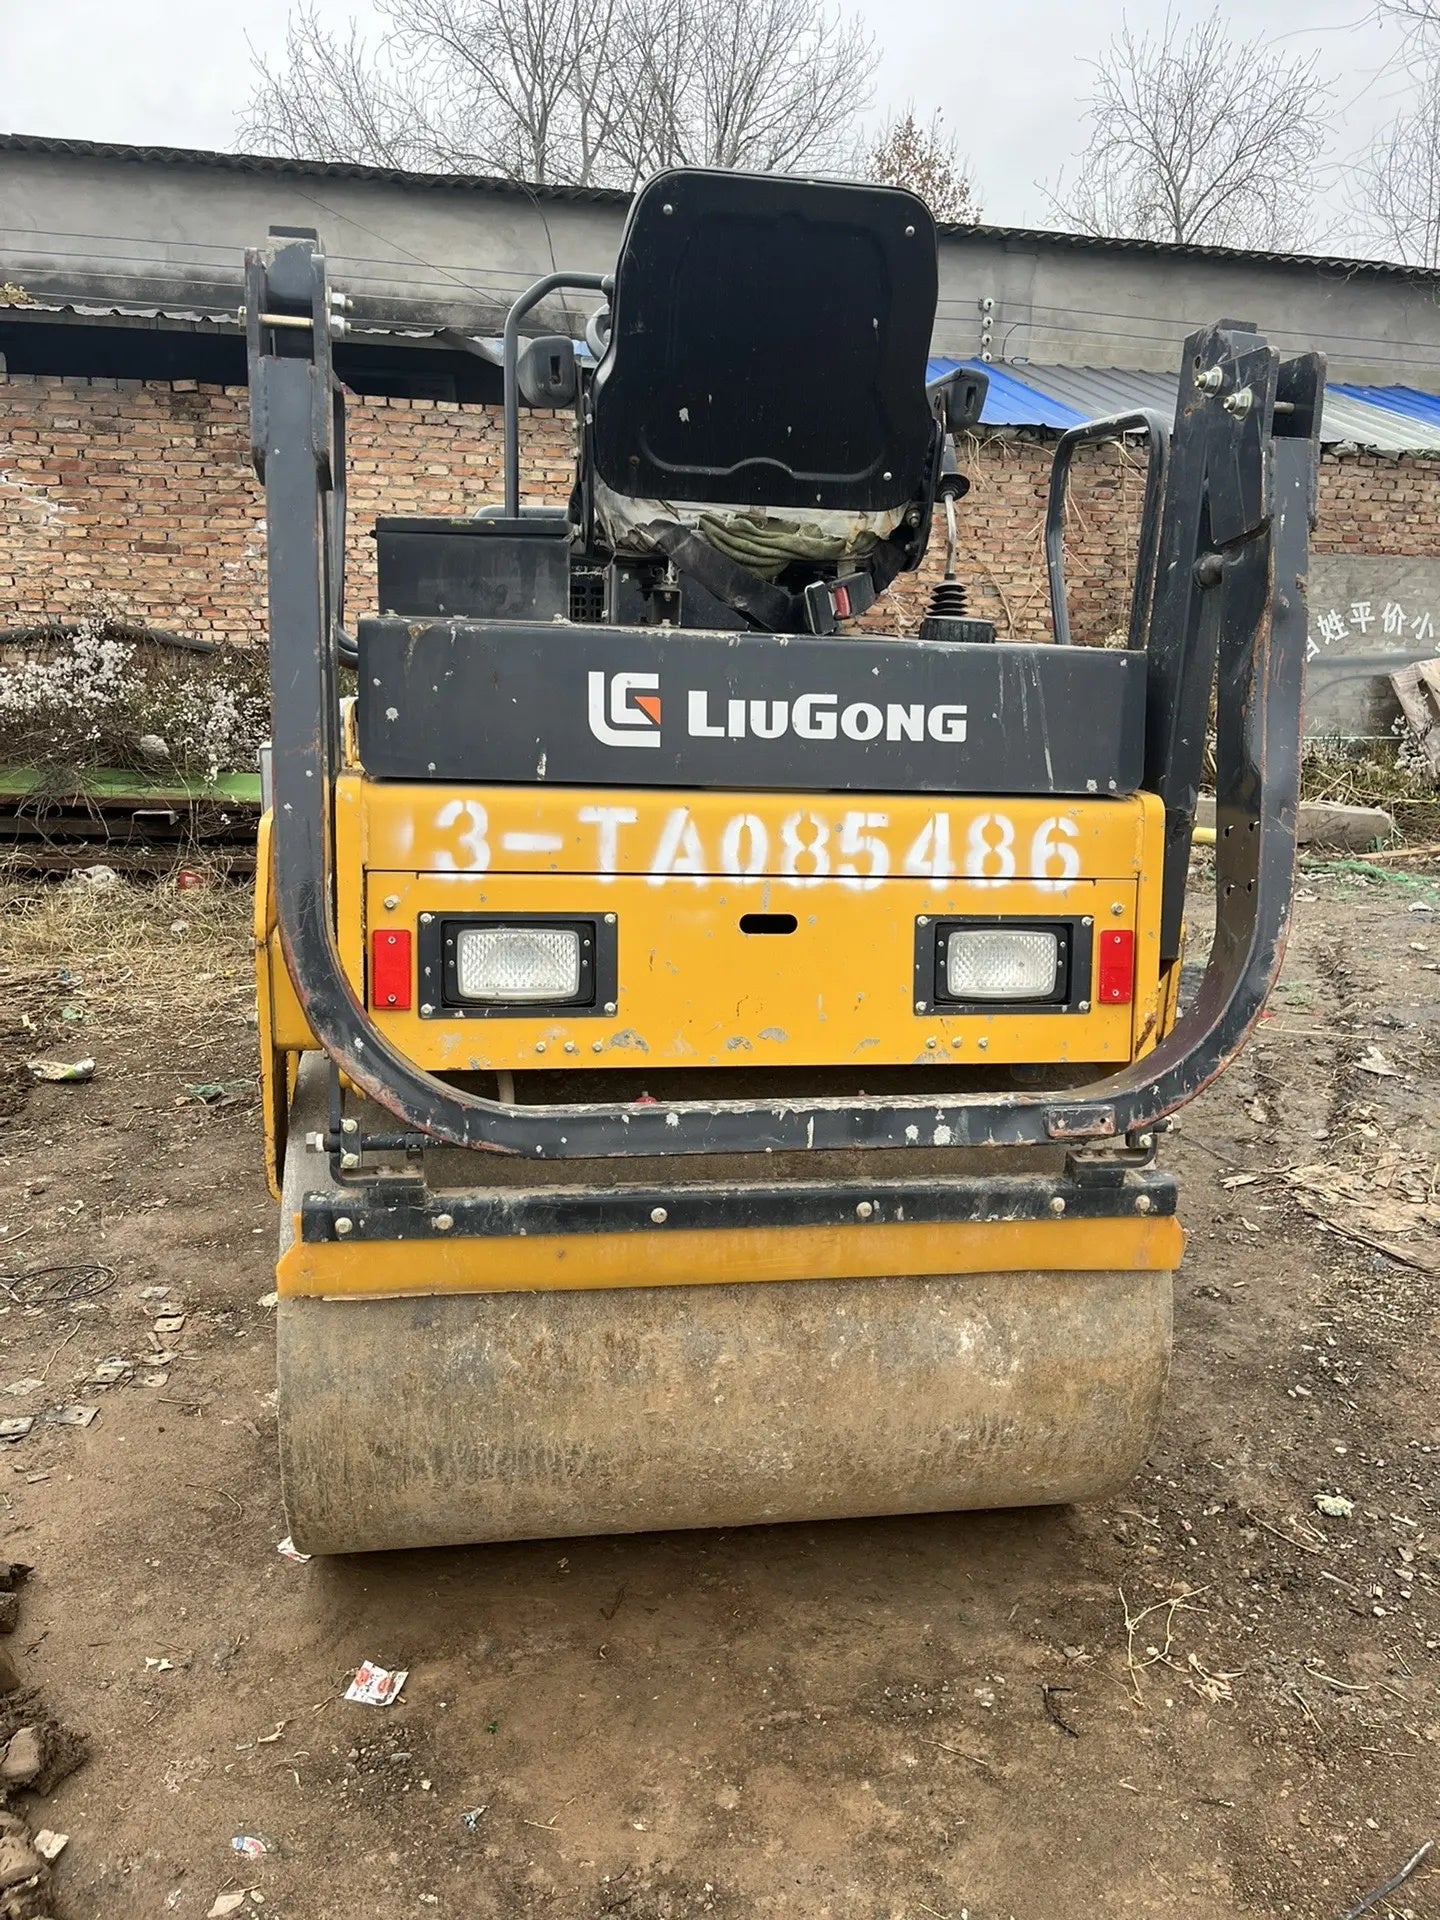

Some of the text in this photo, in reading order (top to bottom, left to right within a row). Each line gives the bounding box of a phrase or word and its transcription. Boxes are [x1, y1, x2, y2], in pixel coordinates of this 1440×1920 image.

[1306, 601, 1440, 663] 姓平价小
[433, 799, 1081, 891] 3-TA085486
